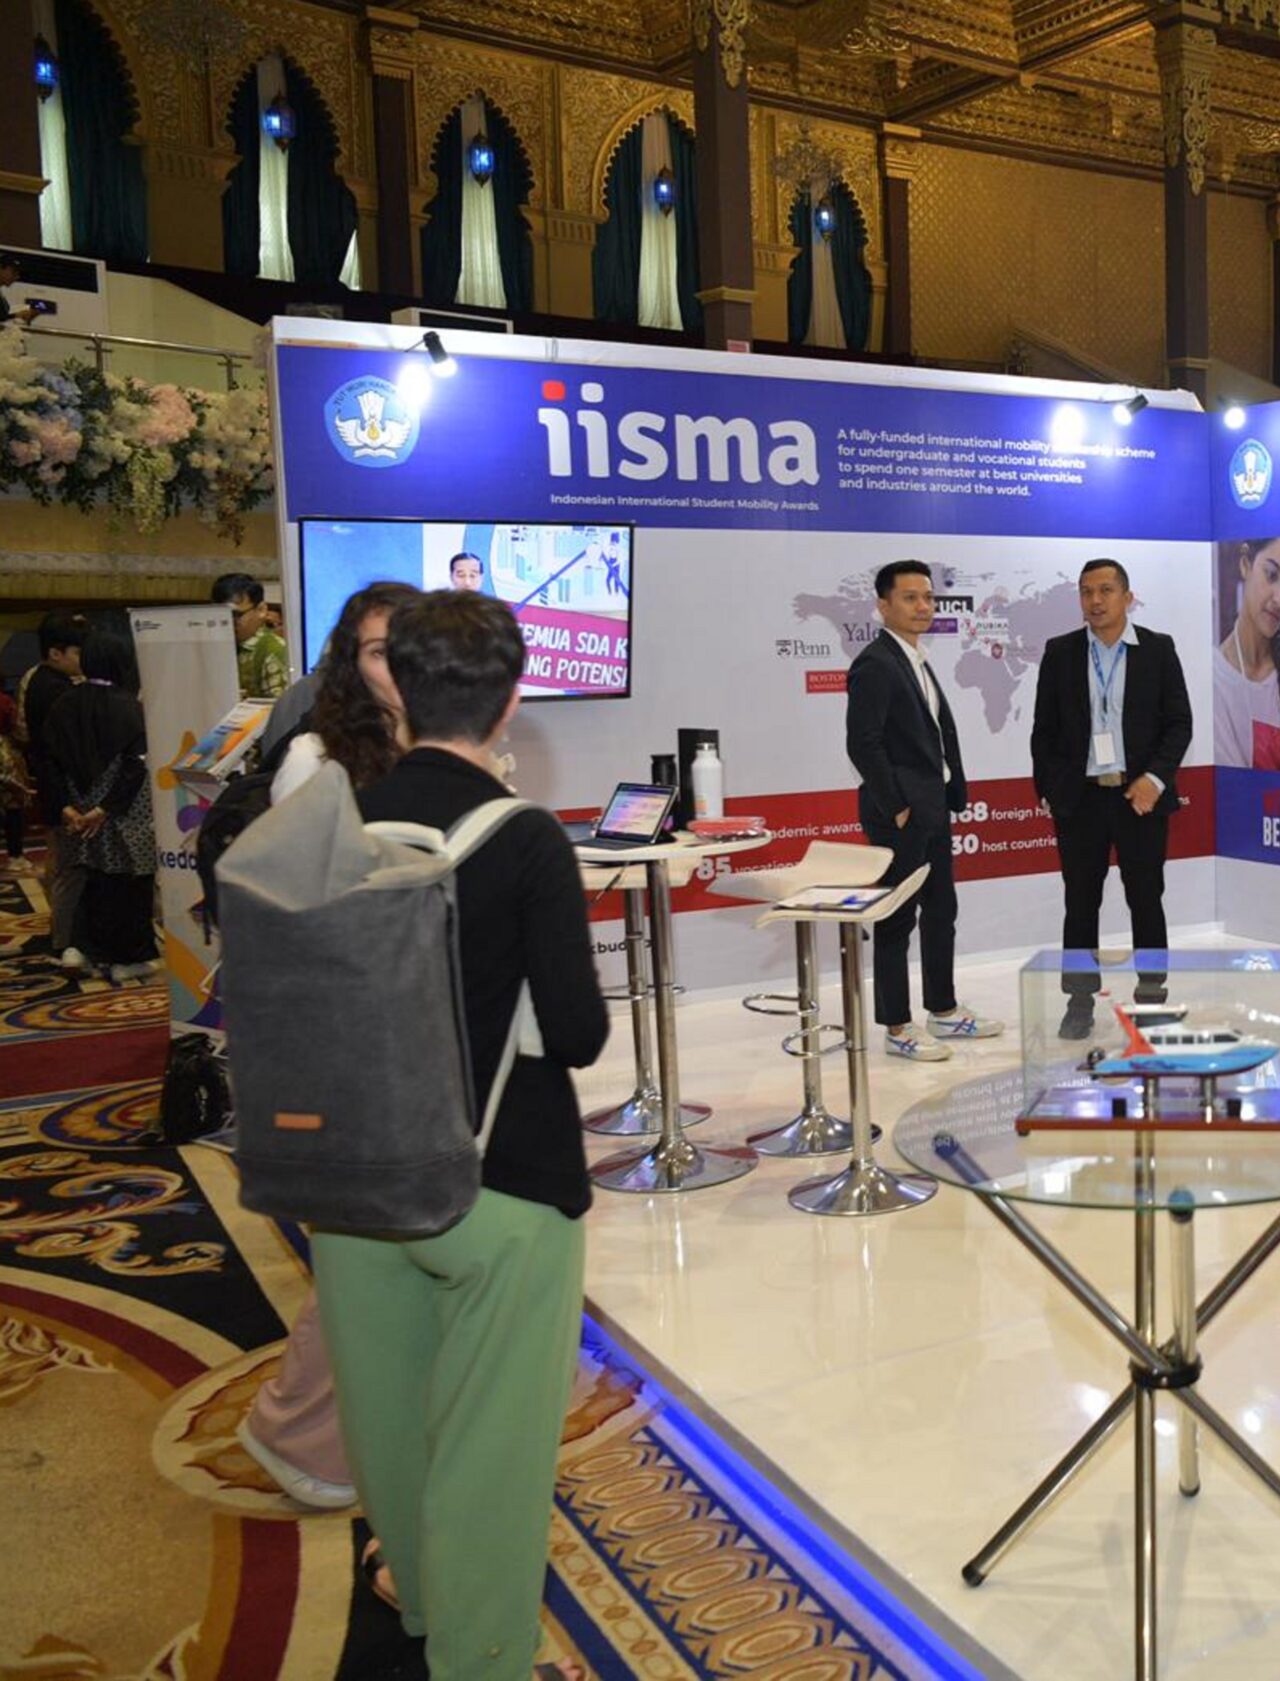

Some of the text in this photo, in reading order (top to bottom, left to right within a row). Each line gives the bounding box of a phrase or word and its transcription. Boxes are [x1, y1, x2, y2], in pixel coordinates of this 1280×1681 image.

[537, 380, 820, 486] iisma
[837, 429, 847, 440] A
[850, 430, 924, 444] fully-funded
[927, 434, 1002, 448] international
[1004, 439, 1050, 454] mobility
[1115, 446, 1156, 459] scheme
[837, 445, 1086, 469] for undergraduate and vocational students
[838, 462, 1083, 484] to spend one semester at best universities
[839, 478, 1031, 497] and industries around the world.
[550, 494, 820, 511] Indonesian International Student Mobility Awards
[843, 622, 880, 642] Yale
[575, 631, 610, 656] SDA
[794, 640, 831, 656] Penn
[556, 657, 628, 688] POTENSI
[991, 806, 1034, 821] foreign
[951, 833, 979, 856] 30
[982, 840, 1008, 853] host
